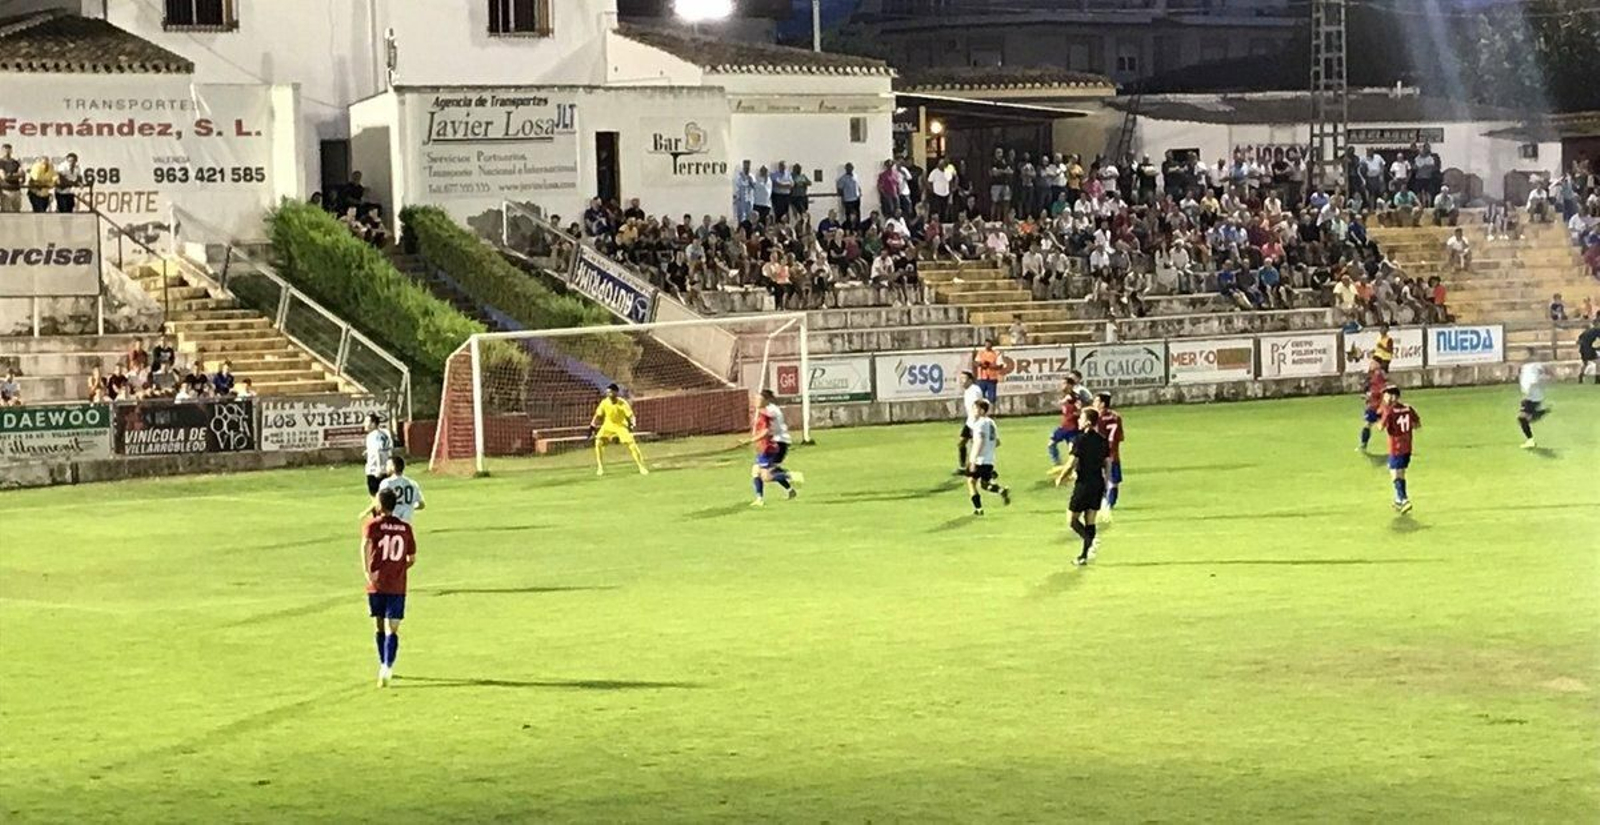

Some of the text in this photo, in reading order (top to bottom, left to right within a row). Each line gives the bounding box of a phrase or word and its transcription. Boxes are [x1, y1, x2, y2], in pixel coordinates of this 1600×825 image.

[432, 95, 472, 111] Agencia
[474, 95, 488, 107] de
[194, 118, 223, 136] S.
[235, 118, 262, 136] L.
[422, 110, 556, 146] Javier Losa
[653, 132, 682, 151] Bar
[670, 151, 727, 175] Terrero
[153, 167, 266, 183] 963 421 585
[1436, 329, 1494, 352] NUEDA
[1087, 360, 1100, 378] EL
[1105, 357, 1154, 377] GALGO
[907, 363, 944, 394] ssg
[3, 409, 101, 429] DAEWOO
[263, 409, 389, 429] LOS VIÑEDS
[1397, 413, 1411, 433] 11
[124, 426, 208, 444] VINÍCOLA DE
[1105, 422, 1119, 442] 7
[124, 440, 207, 455] VILLARROBLEDO
[394, 484, 414, 505] 20
[378, 533, 406, 562] 10
